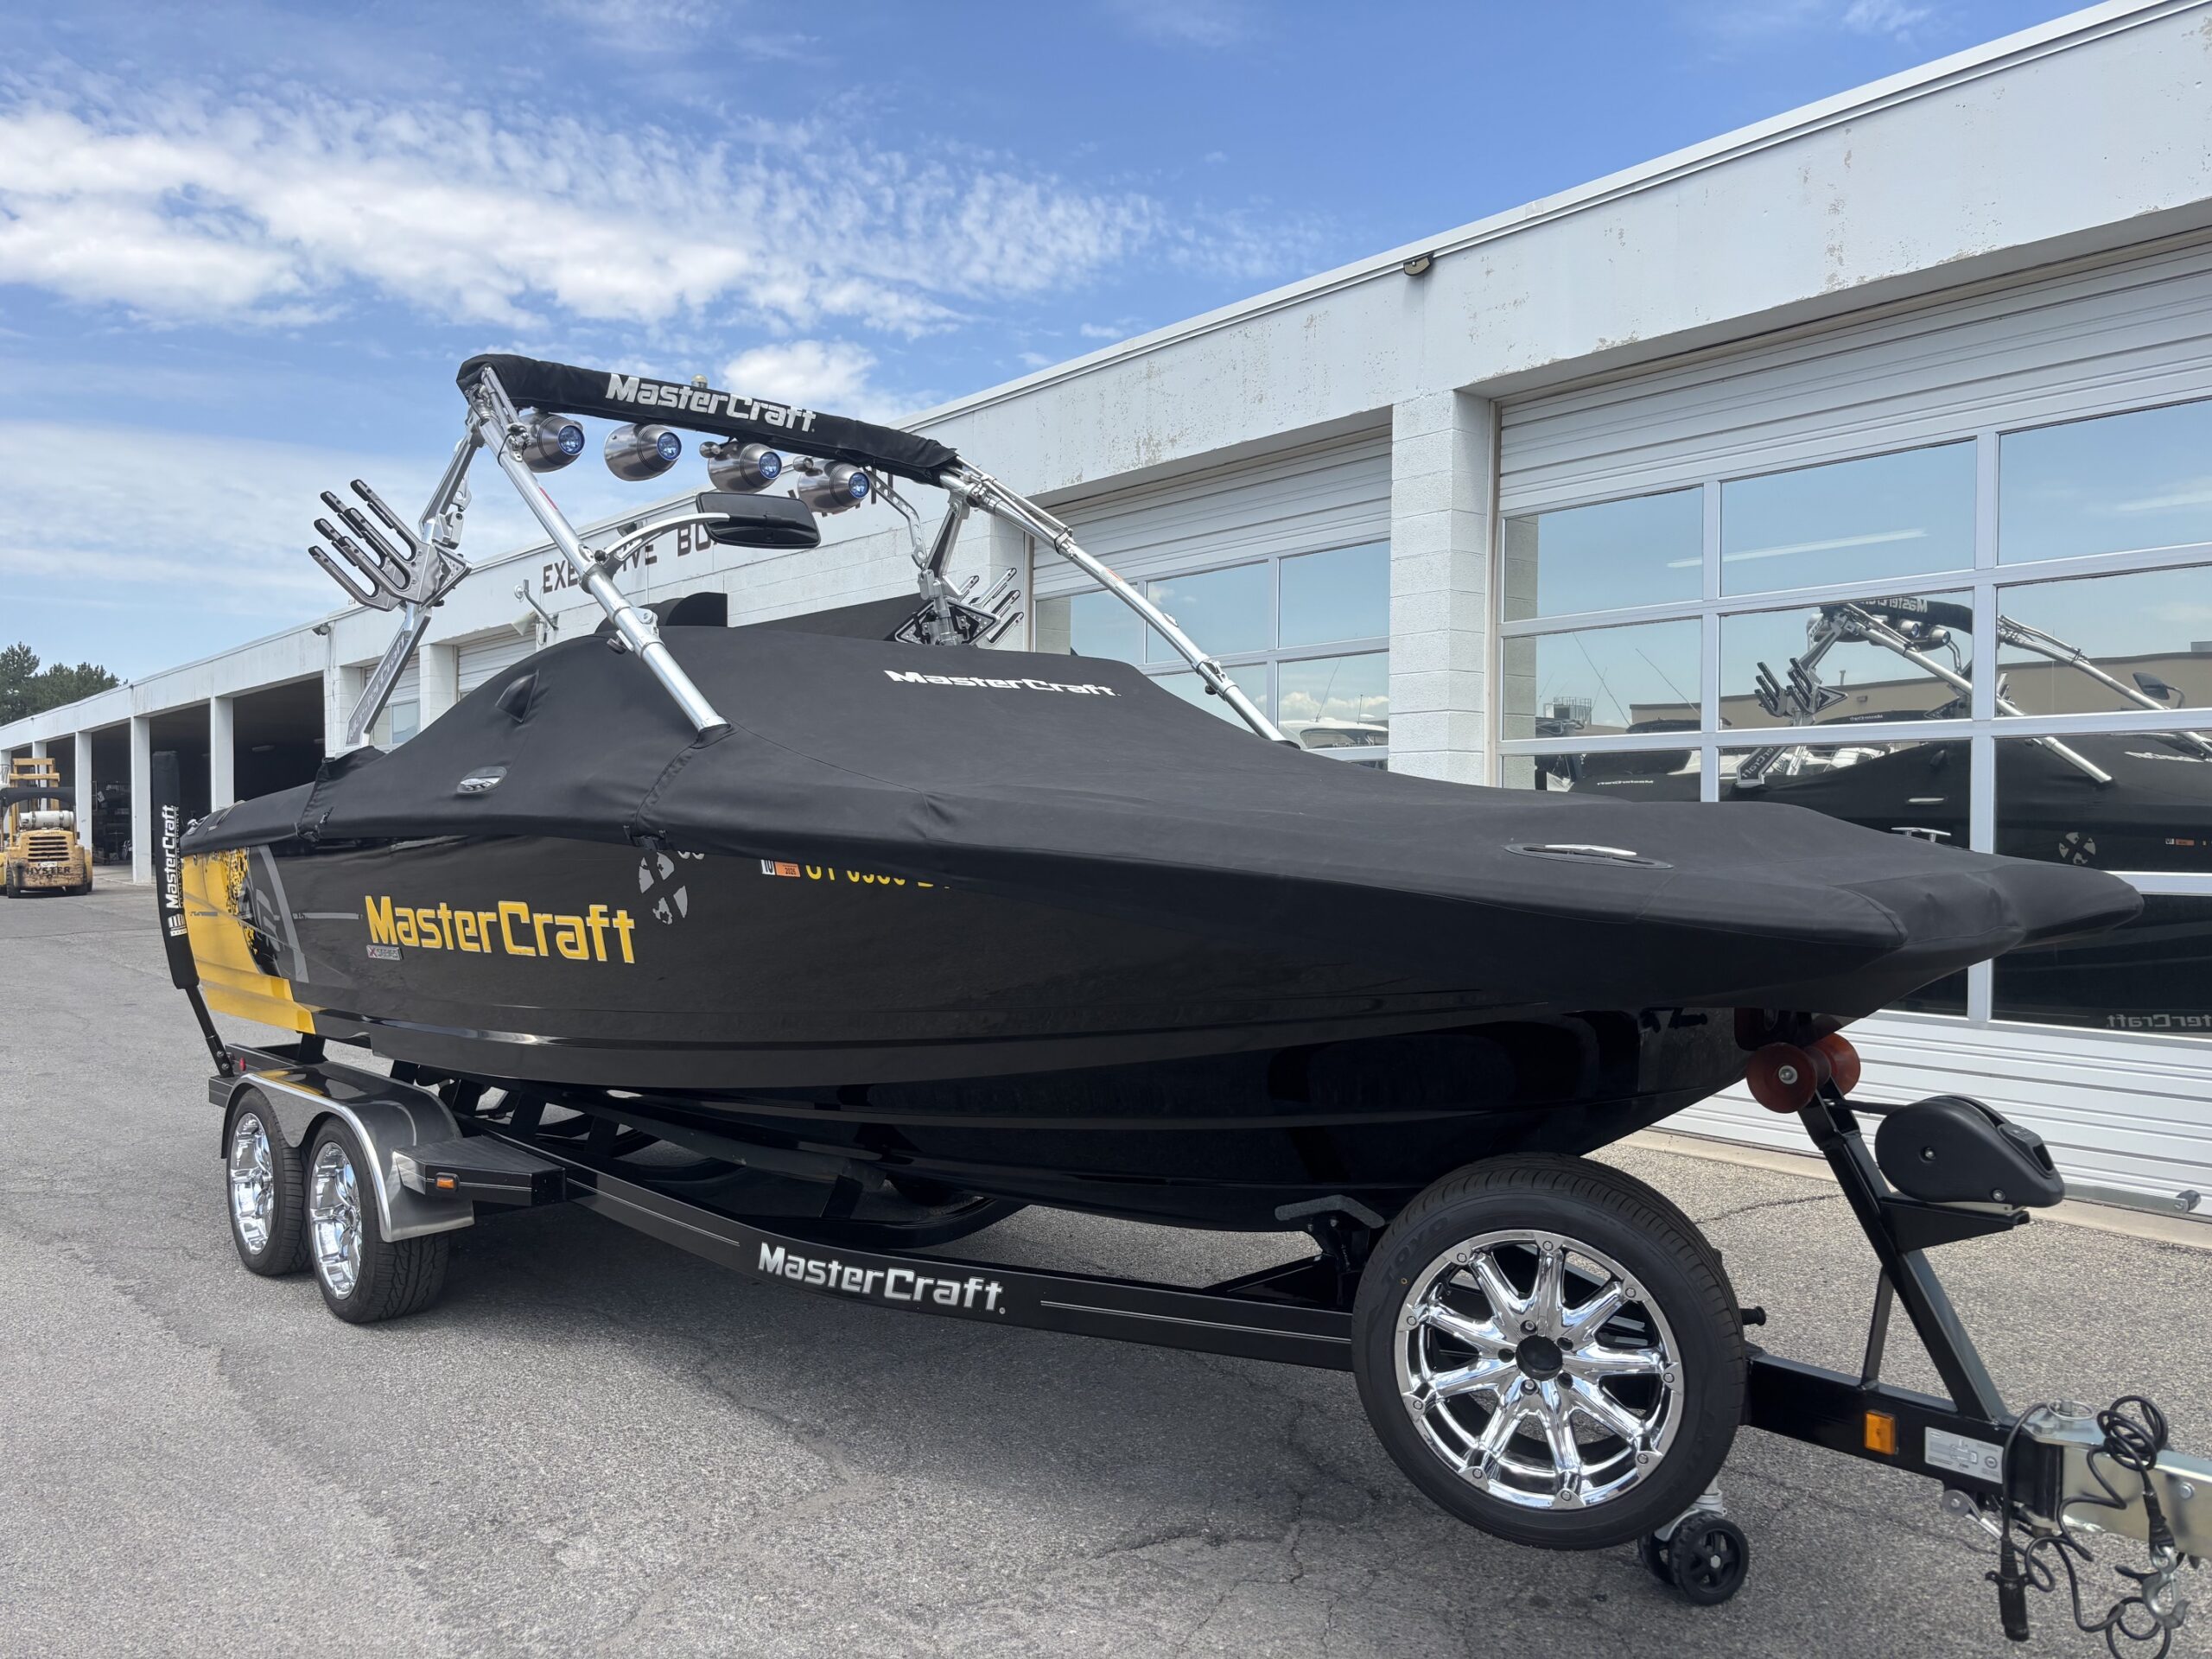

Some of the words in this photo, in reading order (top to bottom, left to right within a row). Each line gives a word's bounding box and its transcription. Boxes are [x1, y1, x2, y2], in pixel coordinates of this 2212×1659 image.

[606, 373, 817, 433] MasterCraft
[883, 670, 1117, 696] MasterCraft
[26, 867, 71, 875] HYSTER
[162, 804, 179, 909] MasterCraft
[365, 895, 635, 963] MasterCraft
[758, 1242, 1003, 1312] MasterCraft
